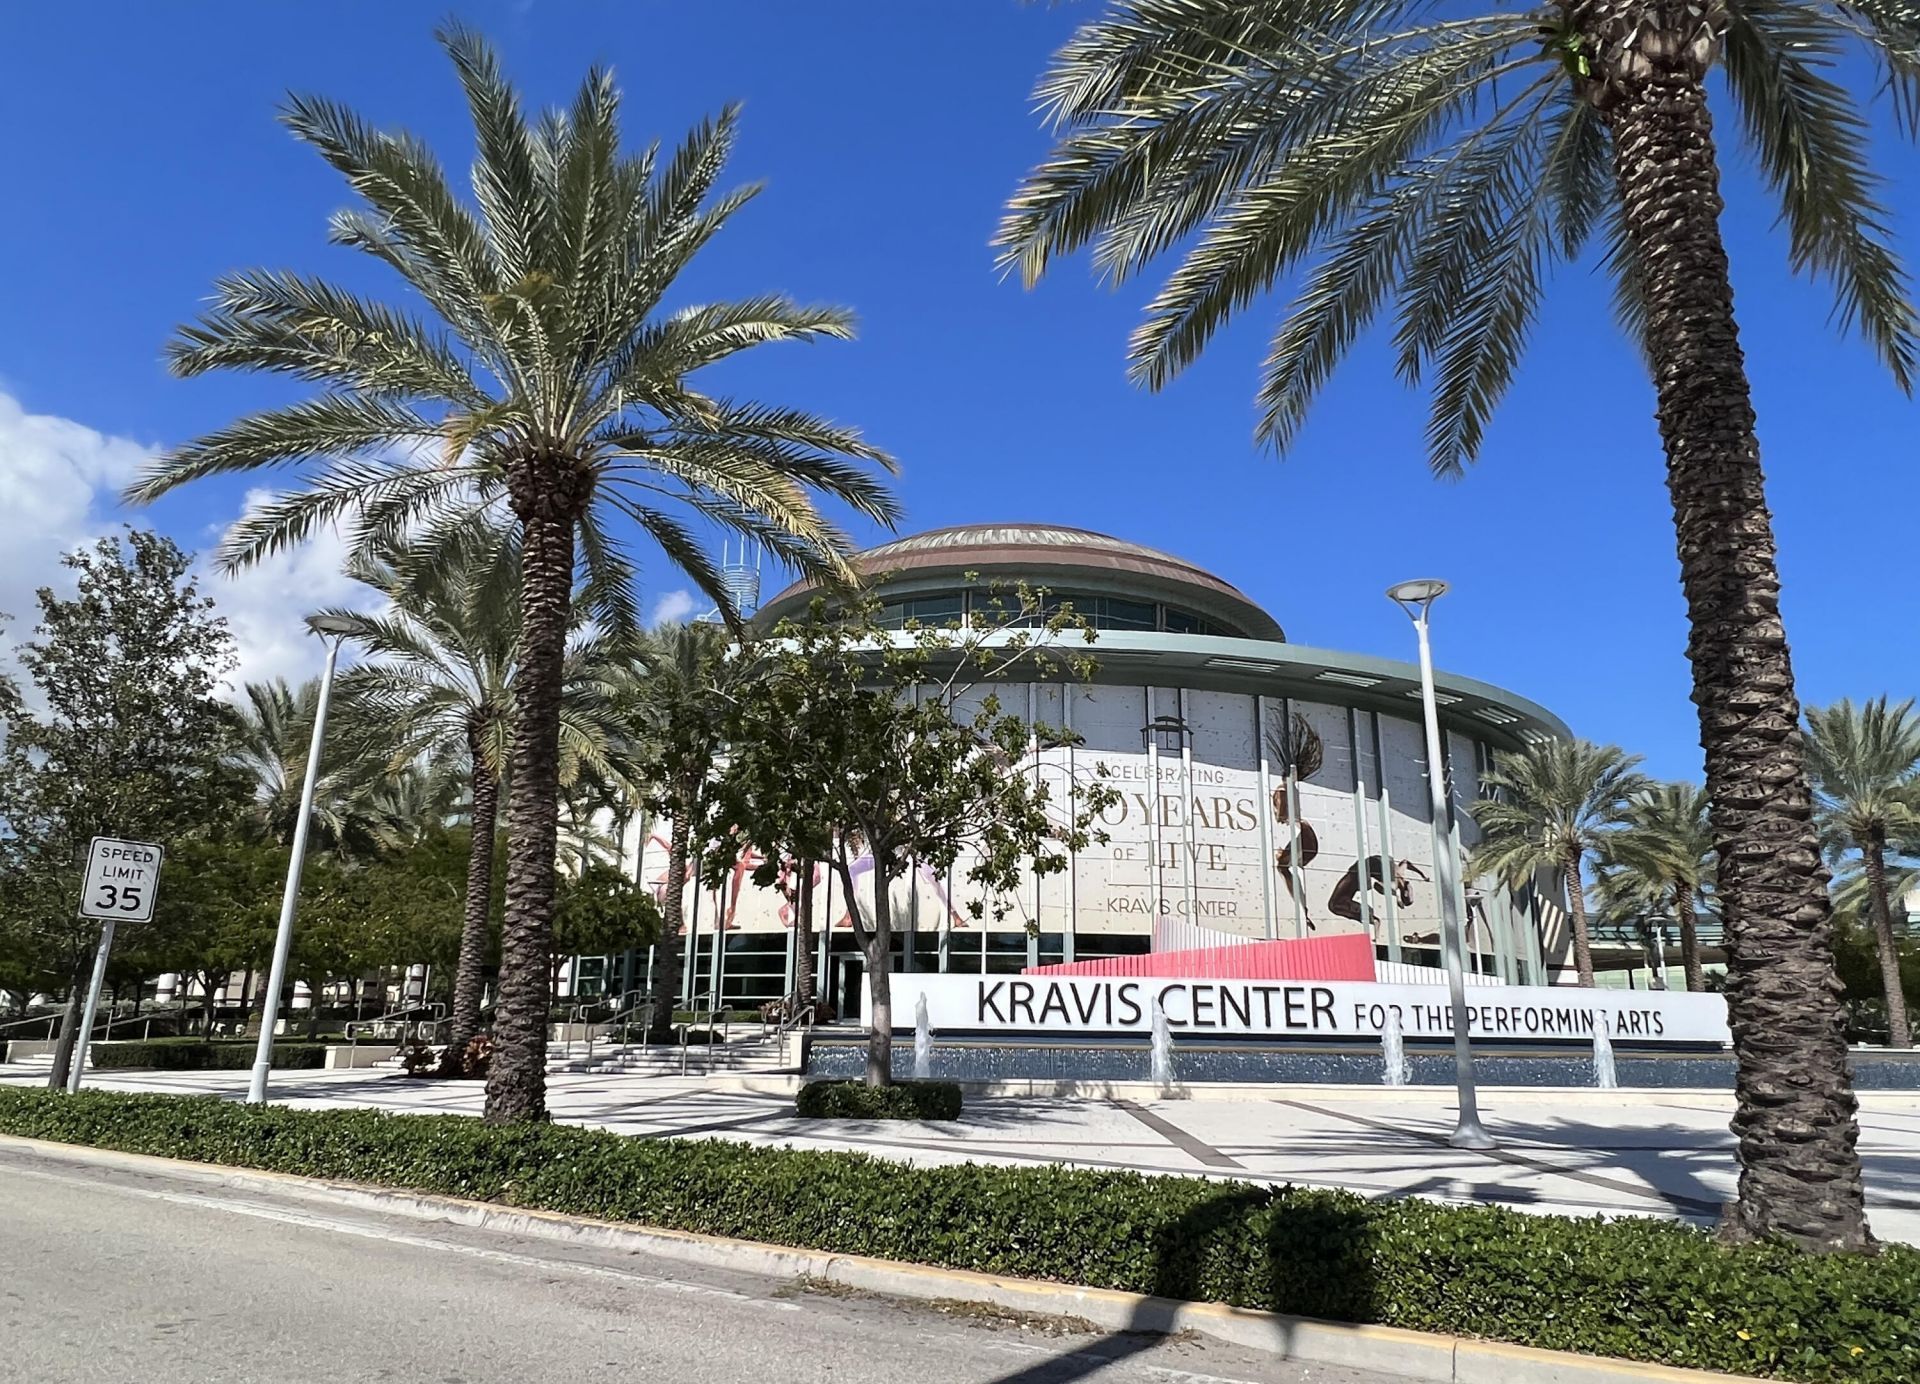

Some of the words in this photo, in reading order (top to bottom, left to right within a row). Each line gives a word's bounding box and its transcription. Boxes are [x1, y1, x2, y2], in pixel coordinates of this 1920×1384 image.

[1131, 793, 1258, 832] YEARS
[100, 847, 153, 863] SPEED
[1113, 848, 1135, 861] OF
[1145, 840, 1227, 871] LIVE
[103, 865, 144, 880] LIMIT
[95, 885, 142, 912] 35
[1107, 897, 1171, 915] KRAVS
[977, 981, 1142, 1026] KRAVIS
[1158, 984, 1337, 1029] CENTER
[1411, 1005, 1455, 1031] THE
[1616, 1009, 1664, 1034] ARTS
